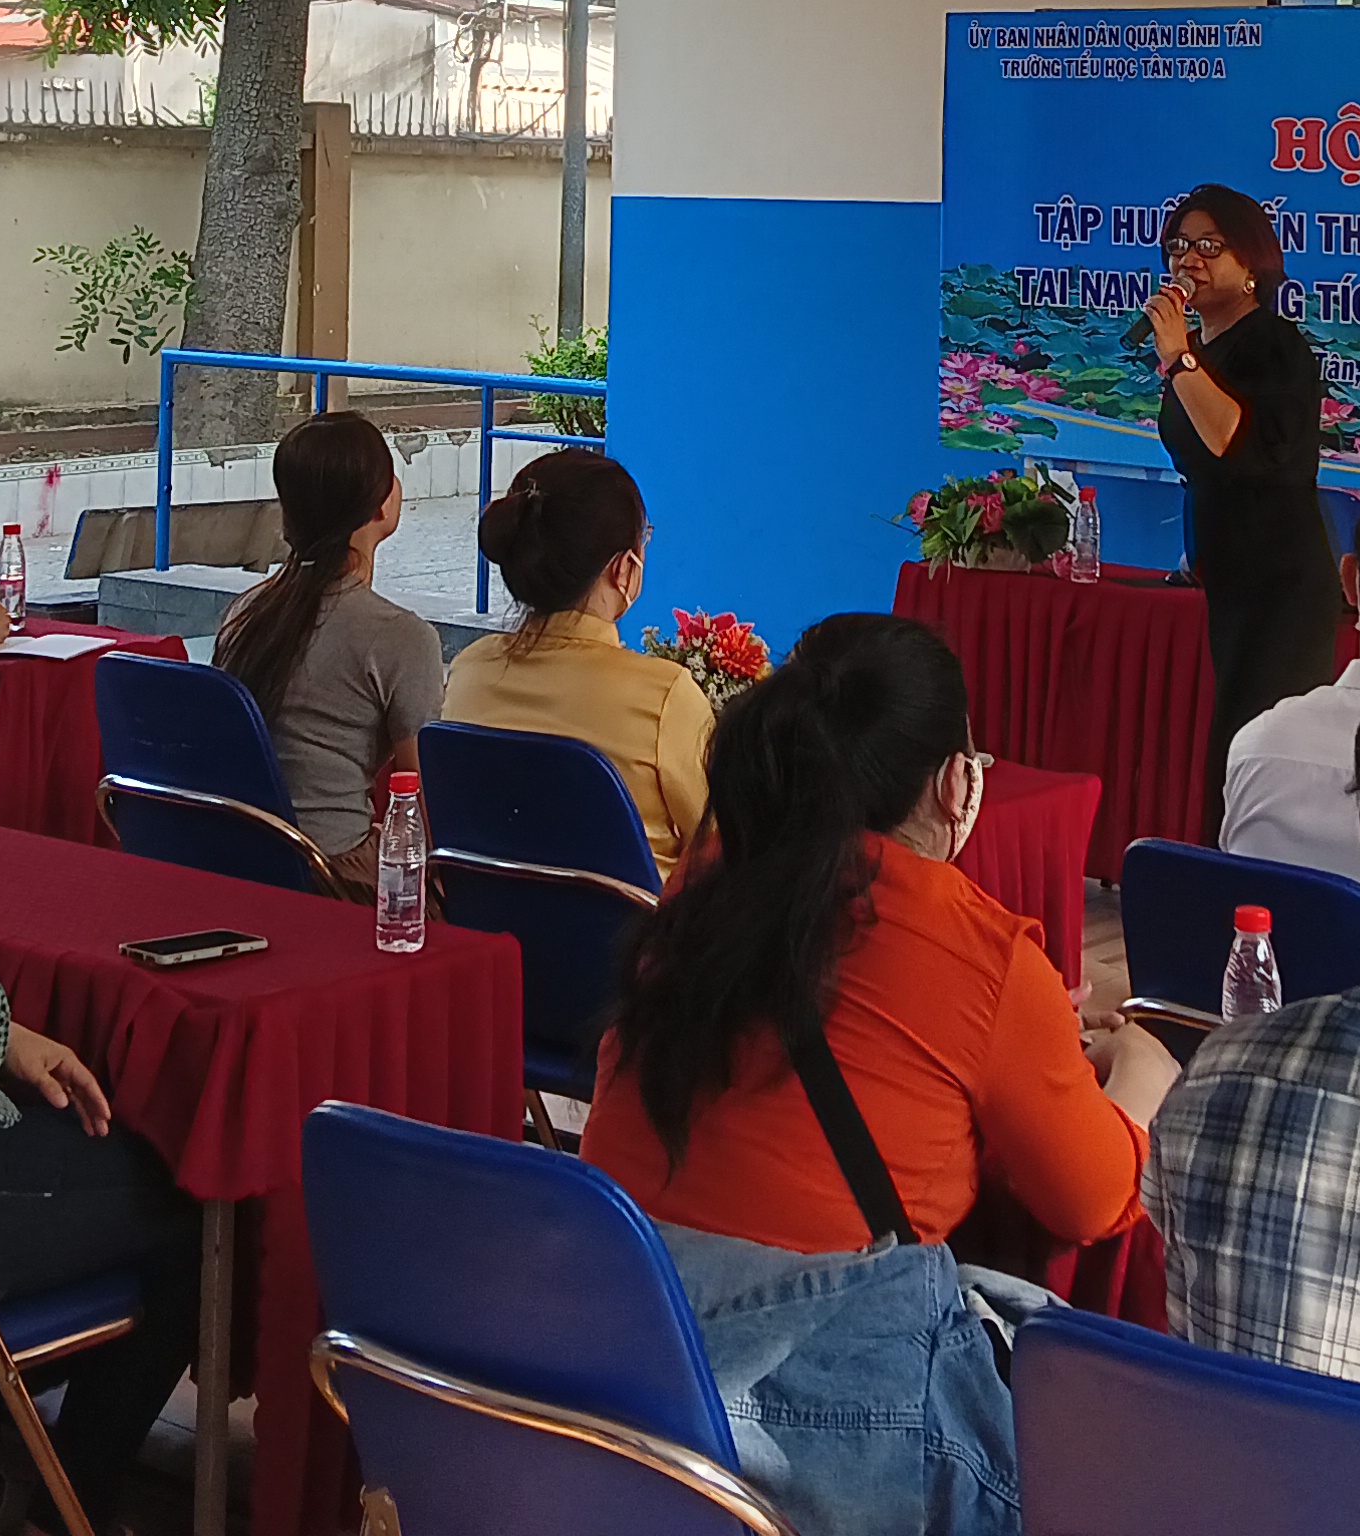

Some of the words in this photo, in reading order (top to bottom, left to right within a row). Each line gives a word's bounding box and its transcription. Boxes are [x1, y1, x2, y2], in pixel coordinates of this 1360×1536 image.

[968, 20, 992, 48] ỦY
[995, 27, 1029, 48] BAN
[1034, 22, 1080, 48] NHÂN
[1085, 22, 1120, 48] DÂN
[1125, 21, 1173, 51] QUẬN
[1178, 20, 1219, 47] BÌNH
[1225, 19, 1261, 47] TÂN
[1001, 53, 1061, 79] TRƯỜNG
[1066, 50, 1100, 78] TIỂU
[1104, 58, 1137, 81] HỌC
[1141, 53, 1173, 78] TÂN
[1177, 58, 1209, 82] TẠO
[1211, 58, 1226, 78] A
[1034, 195, 1102, 250] TẬP
[1015, 267, 1069, 306] TAI
[1080, 269, 1151, 317] NẠN
